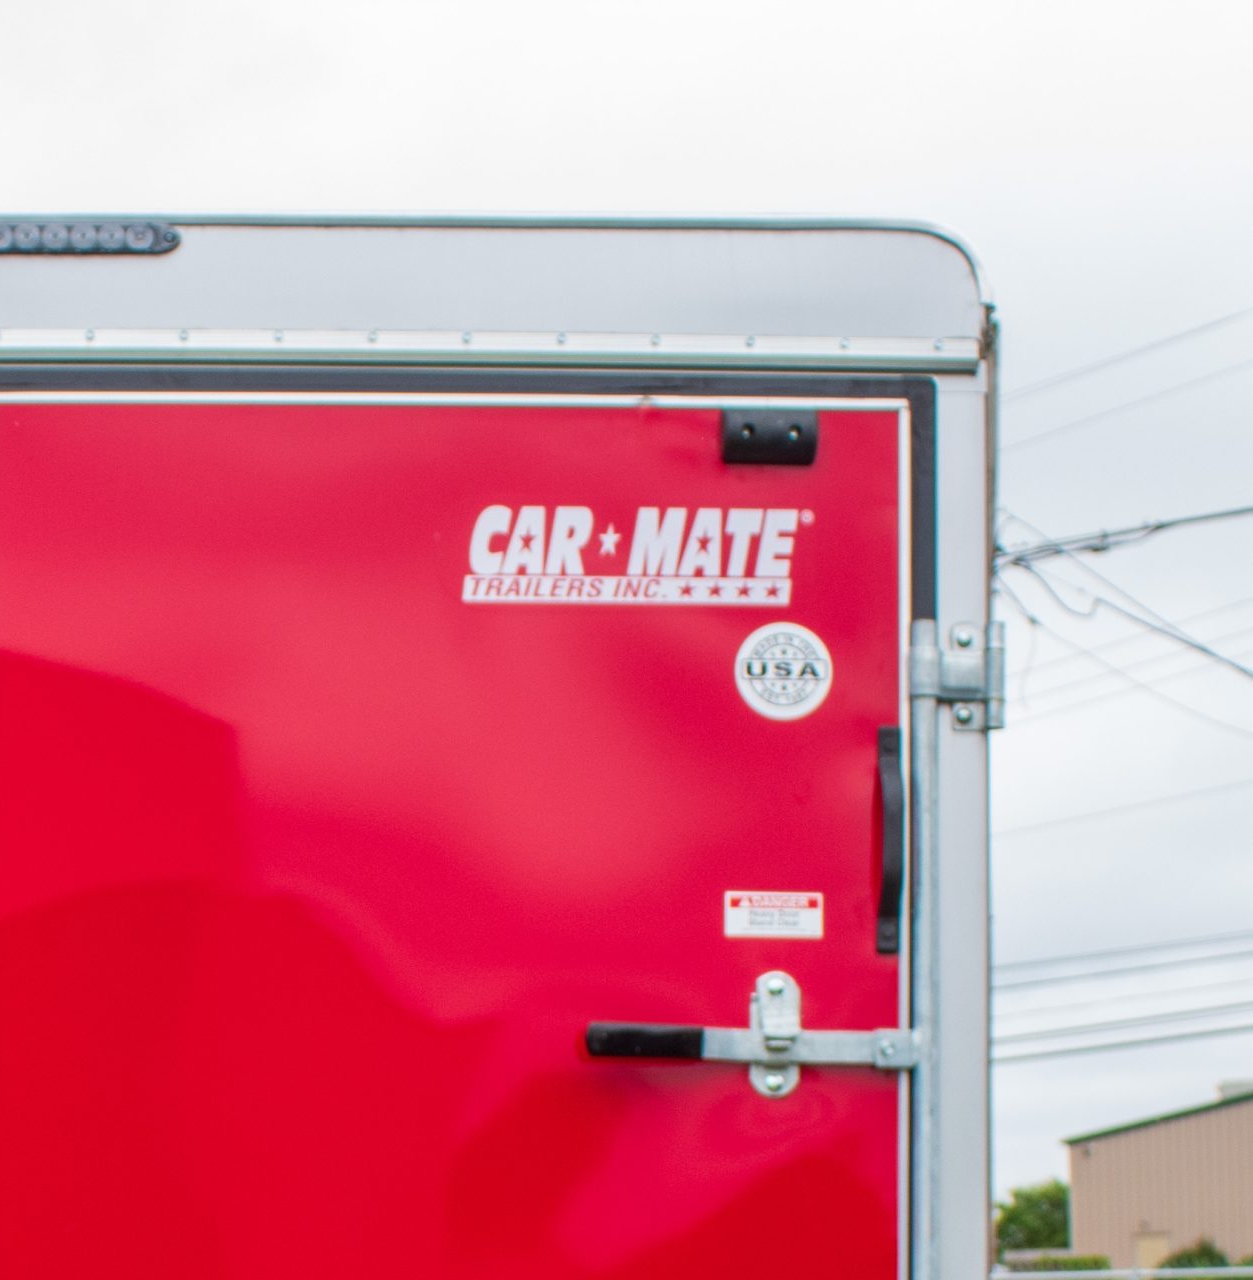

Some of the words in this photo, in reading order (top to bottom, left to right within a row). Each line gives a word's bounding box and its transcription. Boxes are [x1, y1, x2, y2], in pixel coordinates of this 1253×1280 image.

[469, 504, 594, 575] CAR
[471, 577, 603, 597] TRAILERS
[613, 578, 667, 598] INC.
[746, 661, 819, 677] USA
